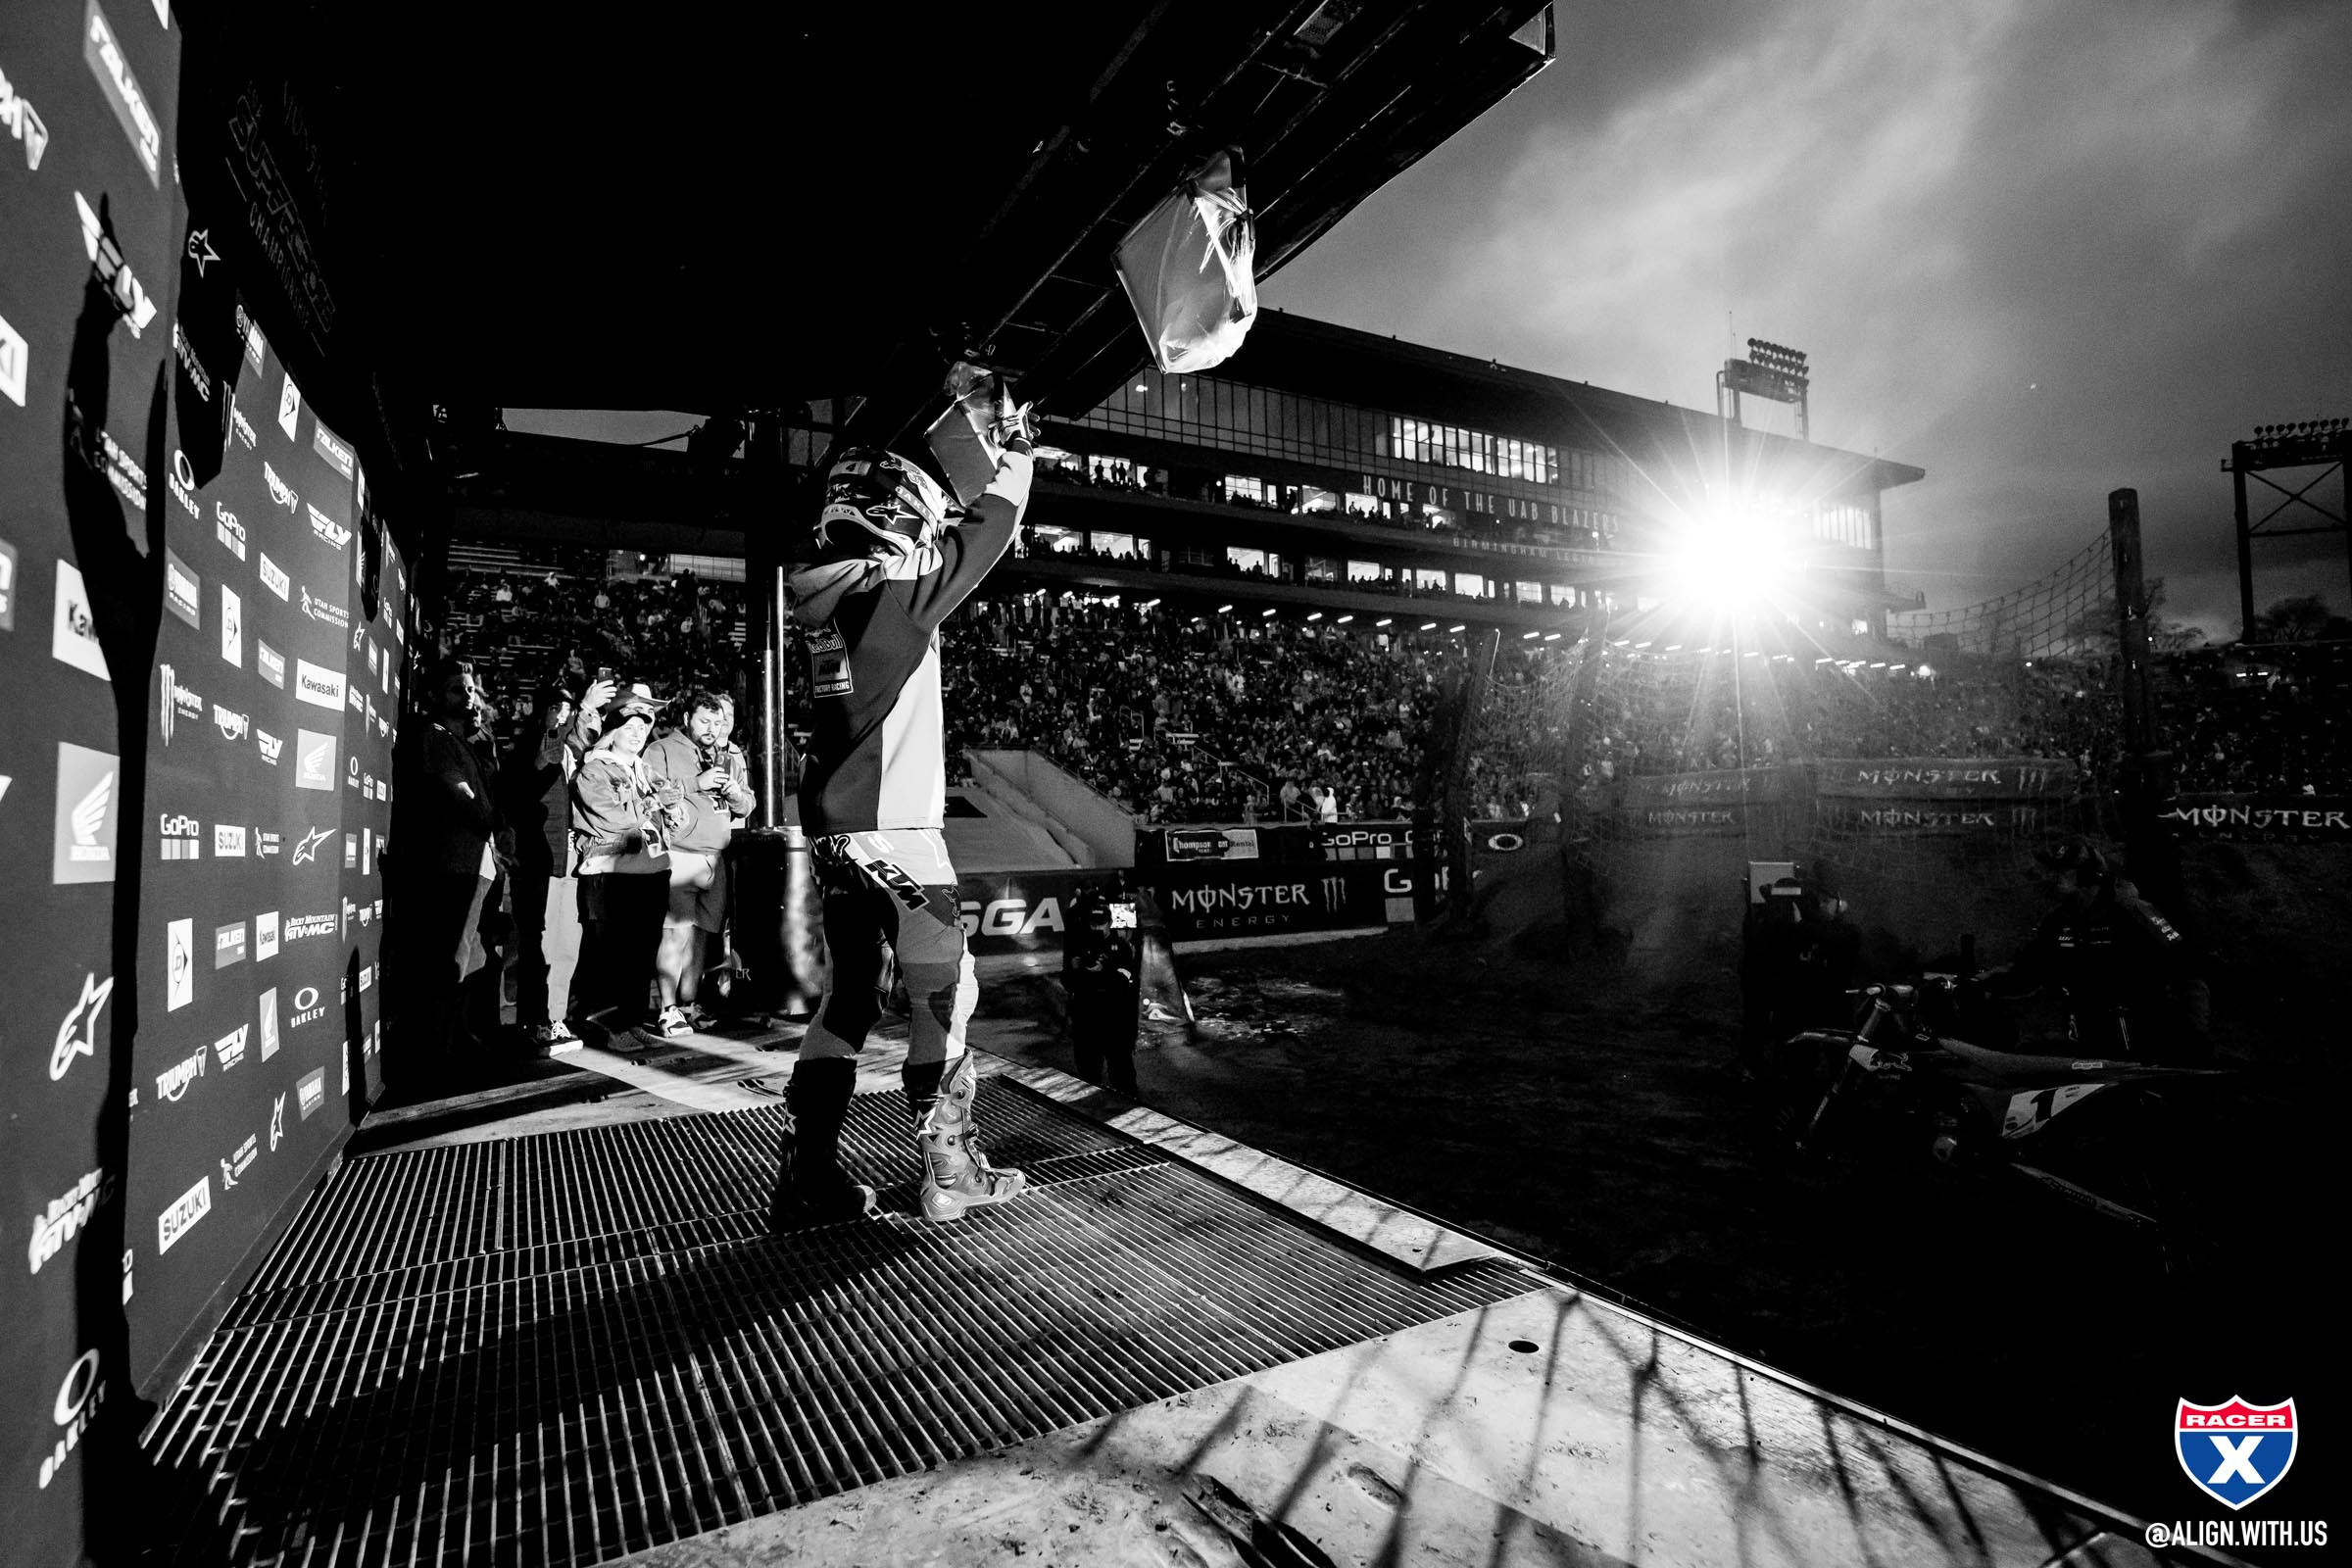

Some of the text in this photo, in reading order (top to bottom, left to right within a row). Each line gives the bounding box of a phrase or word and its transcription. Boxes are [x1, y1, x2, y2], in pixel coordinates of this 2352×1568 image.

[1363, 474, 1413, 502] HOME
[1429, 486, 1448, 508] OF
[1464, 491, 1494, 514] THE
[1508, 498, 1539, 520] UAB
[301, 674, 340, 698] Kawasaki
[160, 813, 200, 837] GoPro
[1196, 914, 1291, 930] ENERGY
[290, 1006, 325, 1029] OAKLEY
[164, 1186, 208, 1241] SUZUKI
